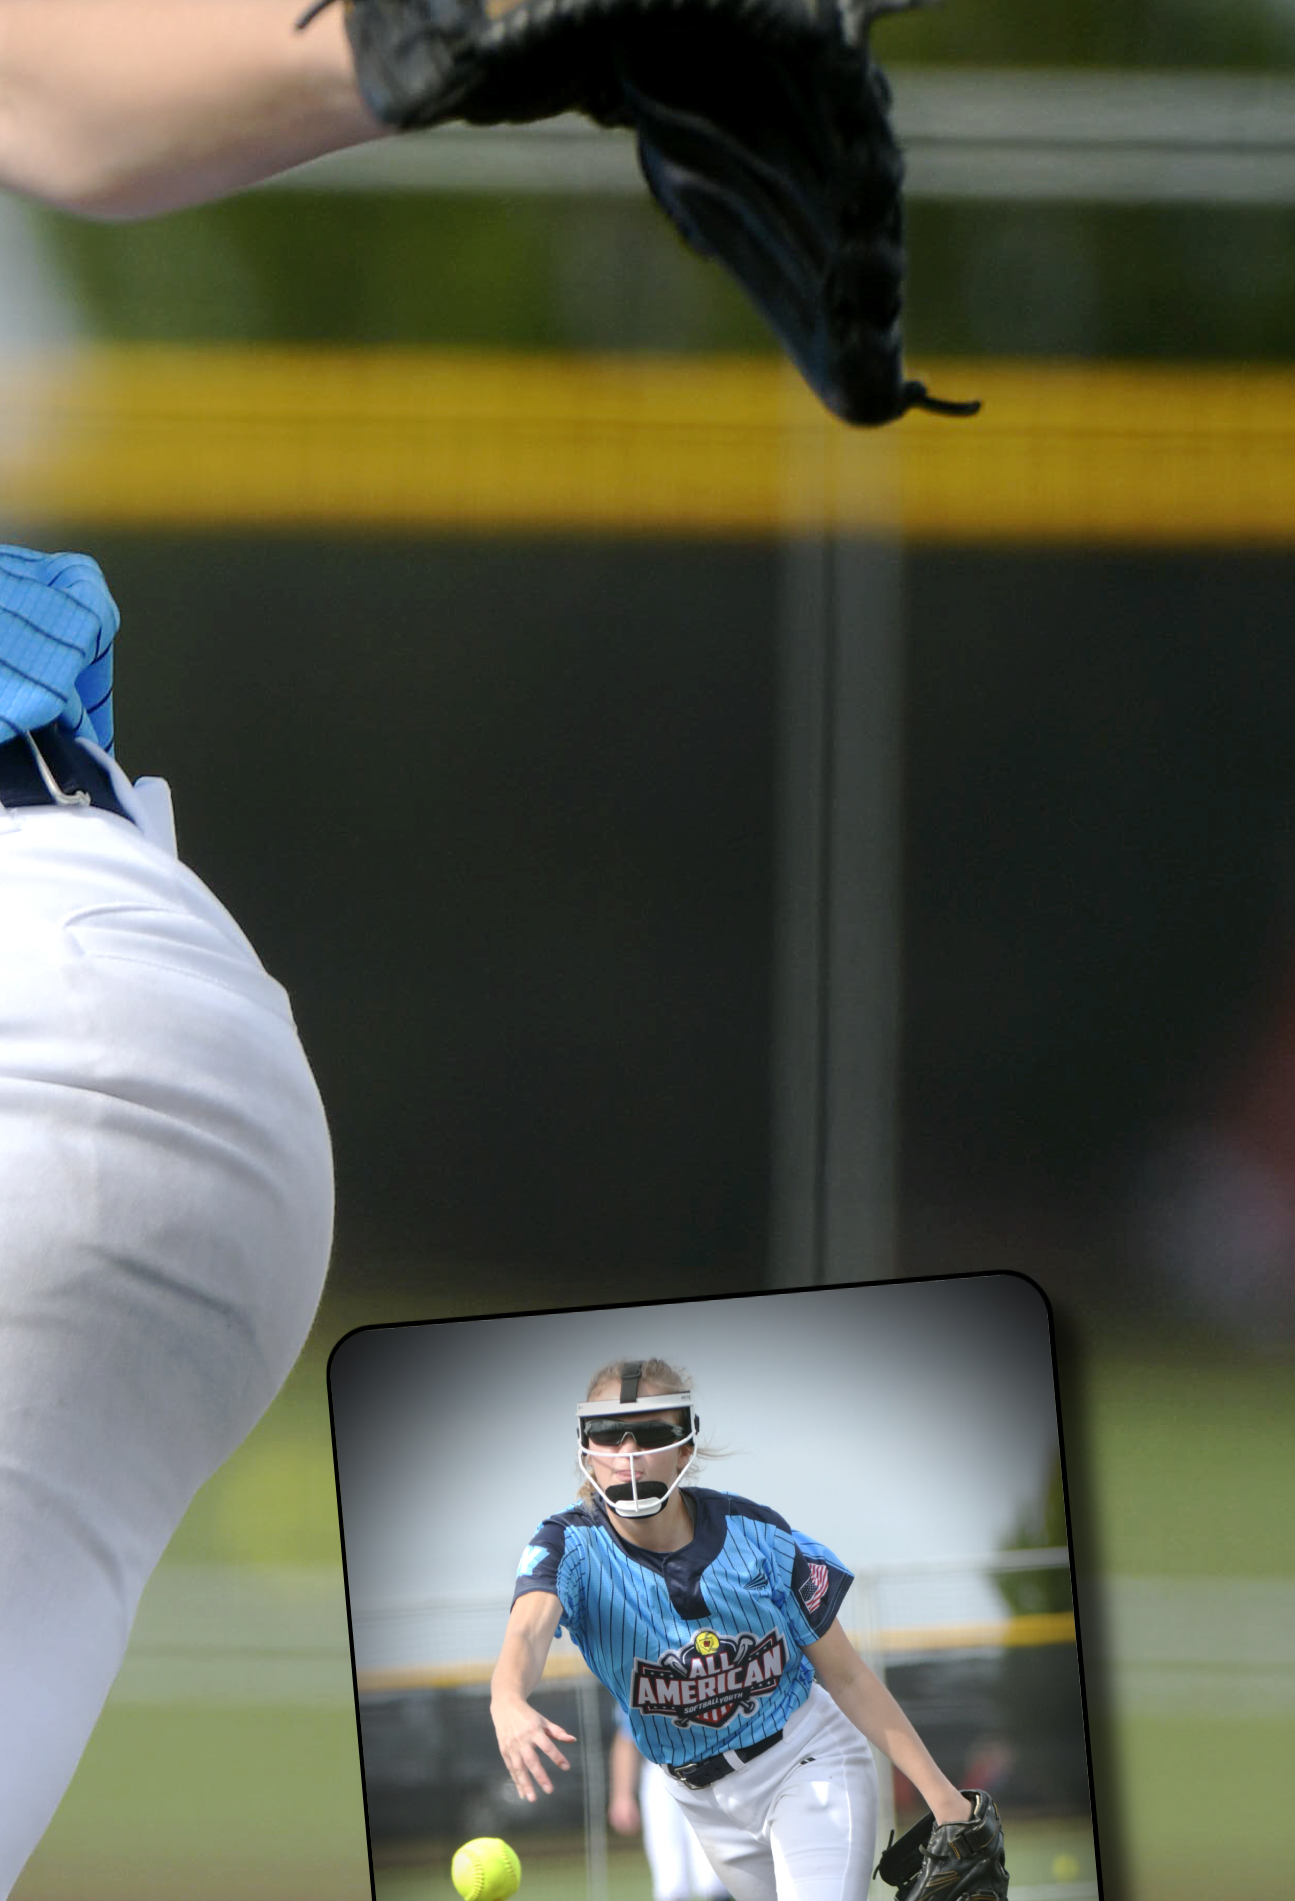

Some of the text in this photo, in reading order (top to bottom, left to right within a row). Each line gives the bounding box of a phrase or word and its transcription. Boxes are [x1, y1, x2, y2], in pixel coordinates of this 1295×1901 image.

[637, 1641, 784, 1706] AMERICAN
[688, 1651, 736, 1679] ALL
[684, 1693, 744, 1714] SOFTBALL YOUTH
